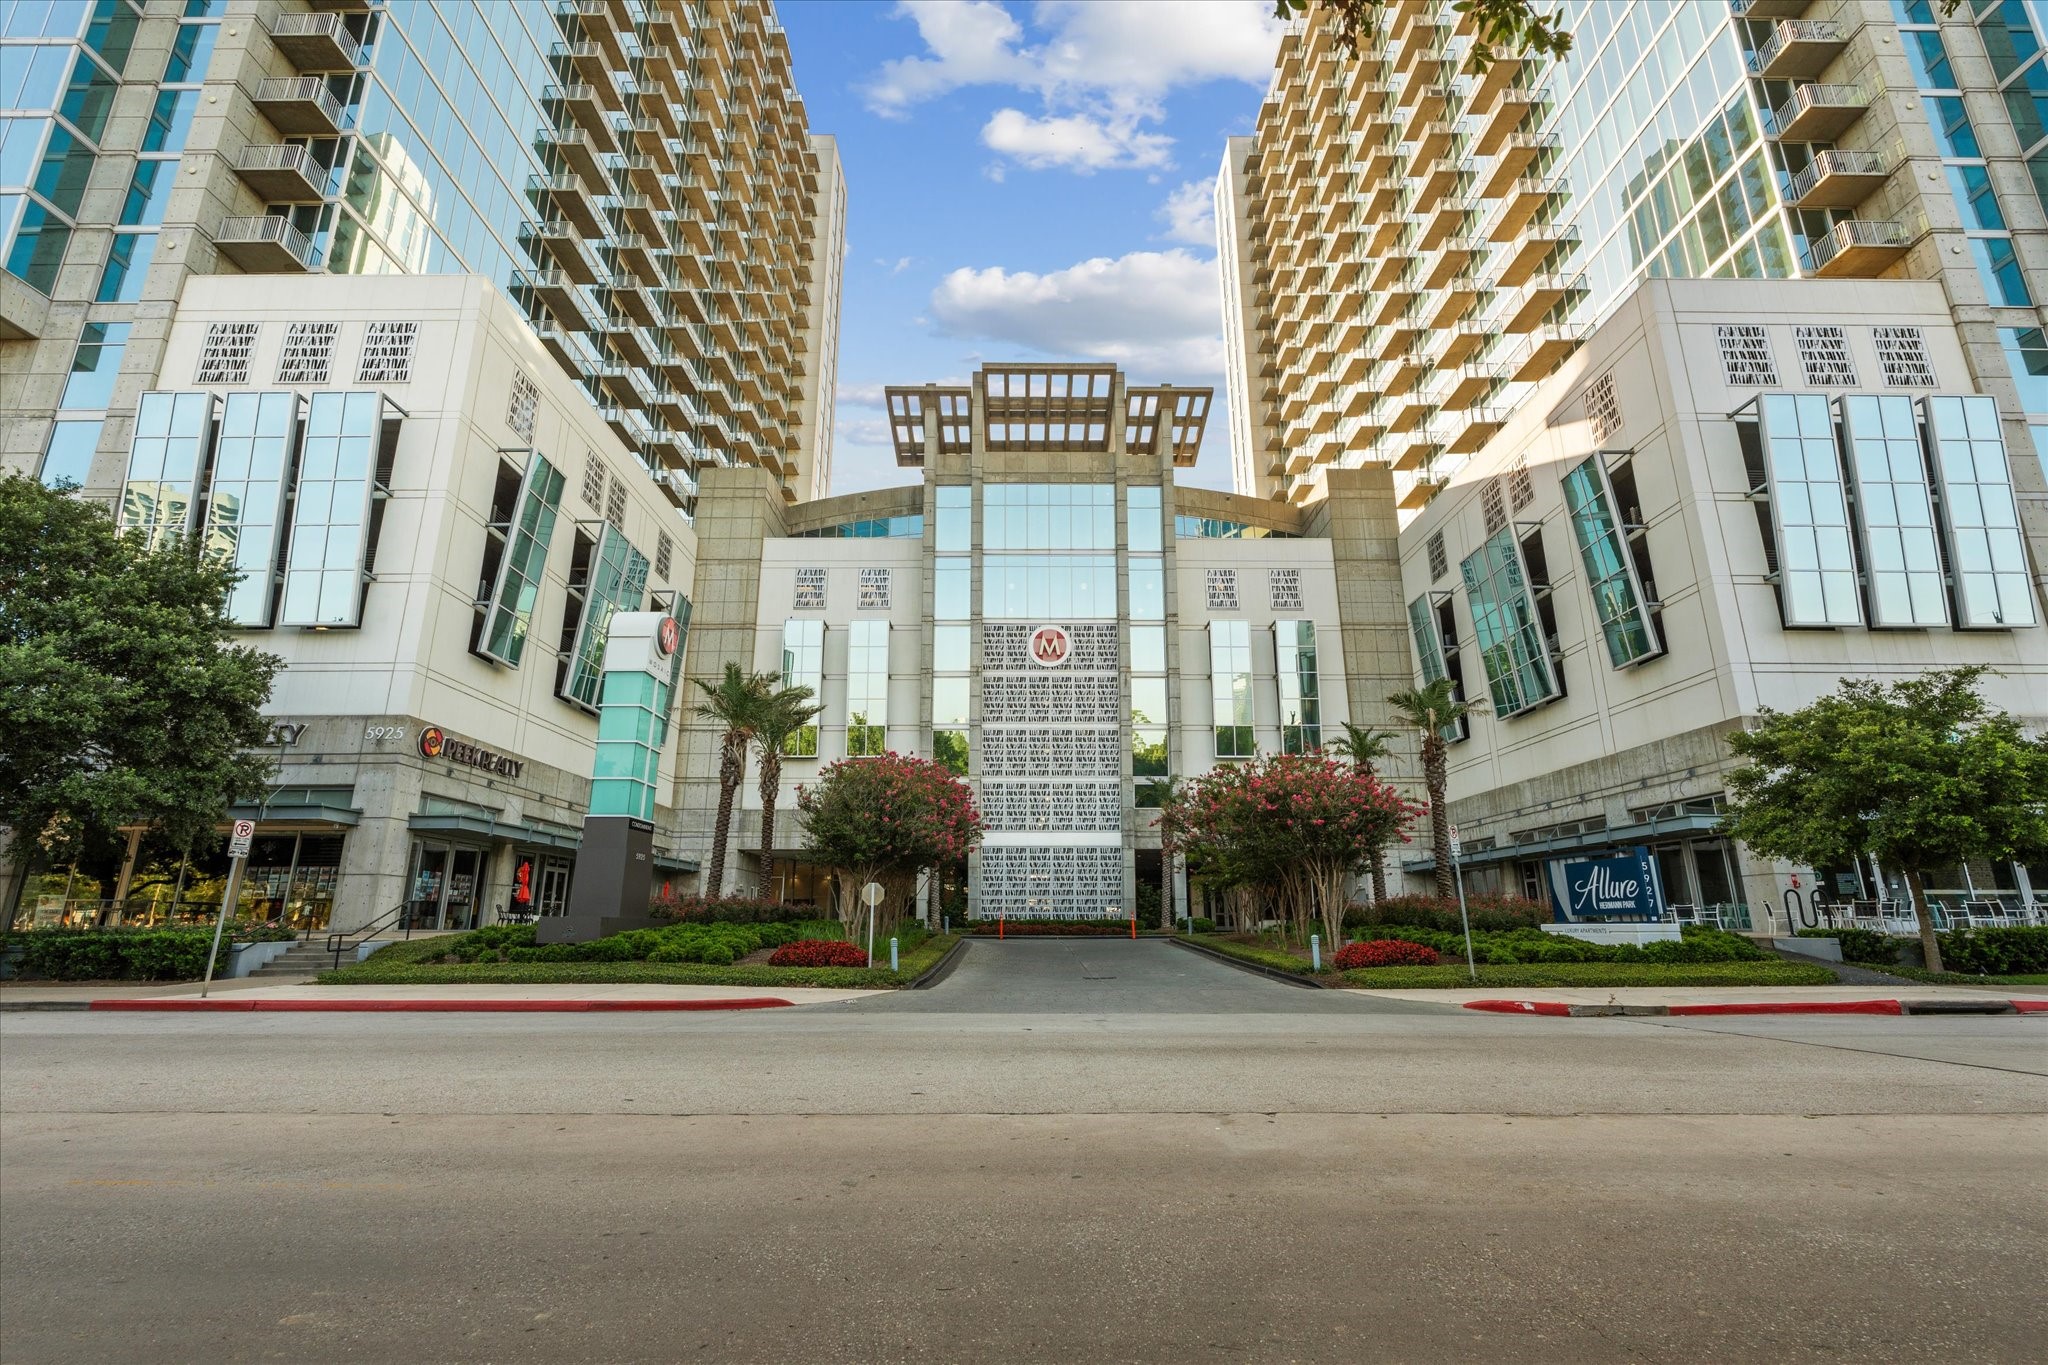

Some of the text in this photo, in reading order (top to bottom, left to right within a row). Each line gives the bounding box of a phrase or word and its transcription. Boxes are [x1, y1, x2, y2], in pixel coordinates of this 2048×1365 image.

[1038, 634, 1061, 657] M
[364, 726, 405, 740] 5925
[1574, 865, 1640, 911] Allure
[1599, 900, 1636, 910] HERMANN PARK
